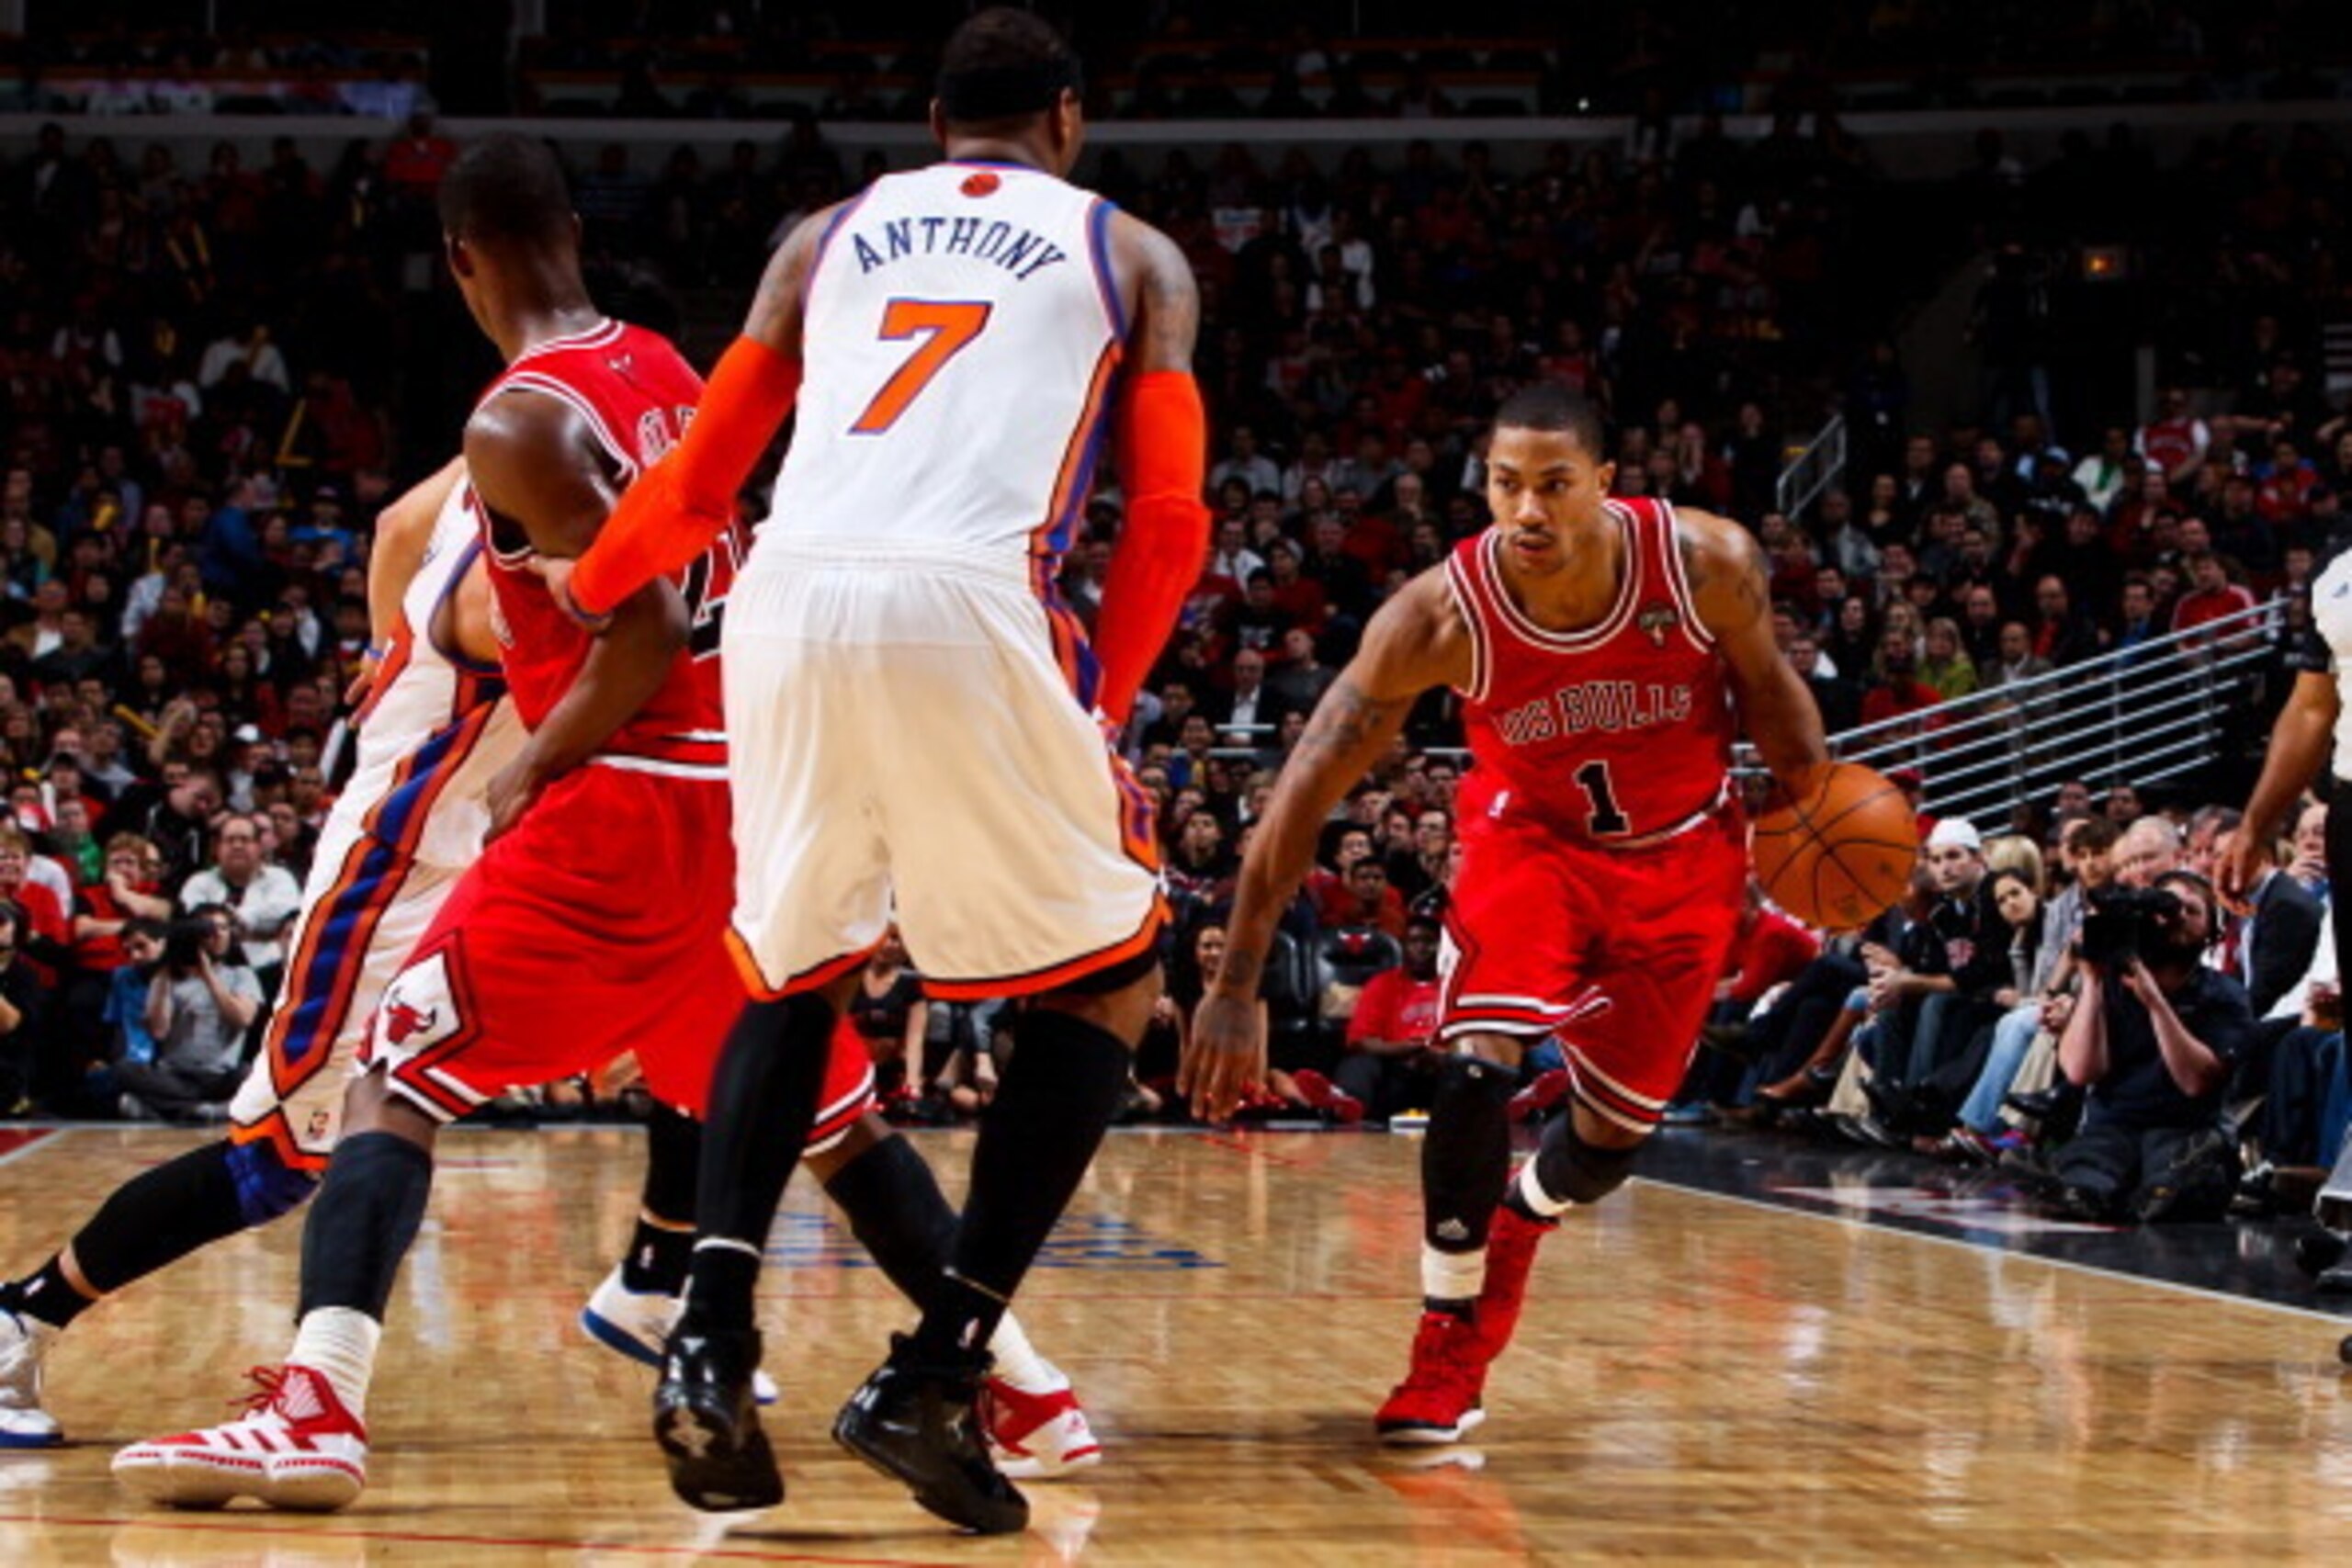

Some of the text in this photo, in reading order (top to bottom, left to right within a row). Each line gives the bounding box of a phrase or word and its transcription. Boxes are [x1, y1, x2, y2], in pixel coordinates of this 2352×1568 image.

[852, 217, 1066, 280] ANTHONY
[848, 298, 993, 434] 7
[1575, 760, 1631, 835] 1
